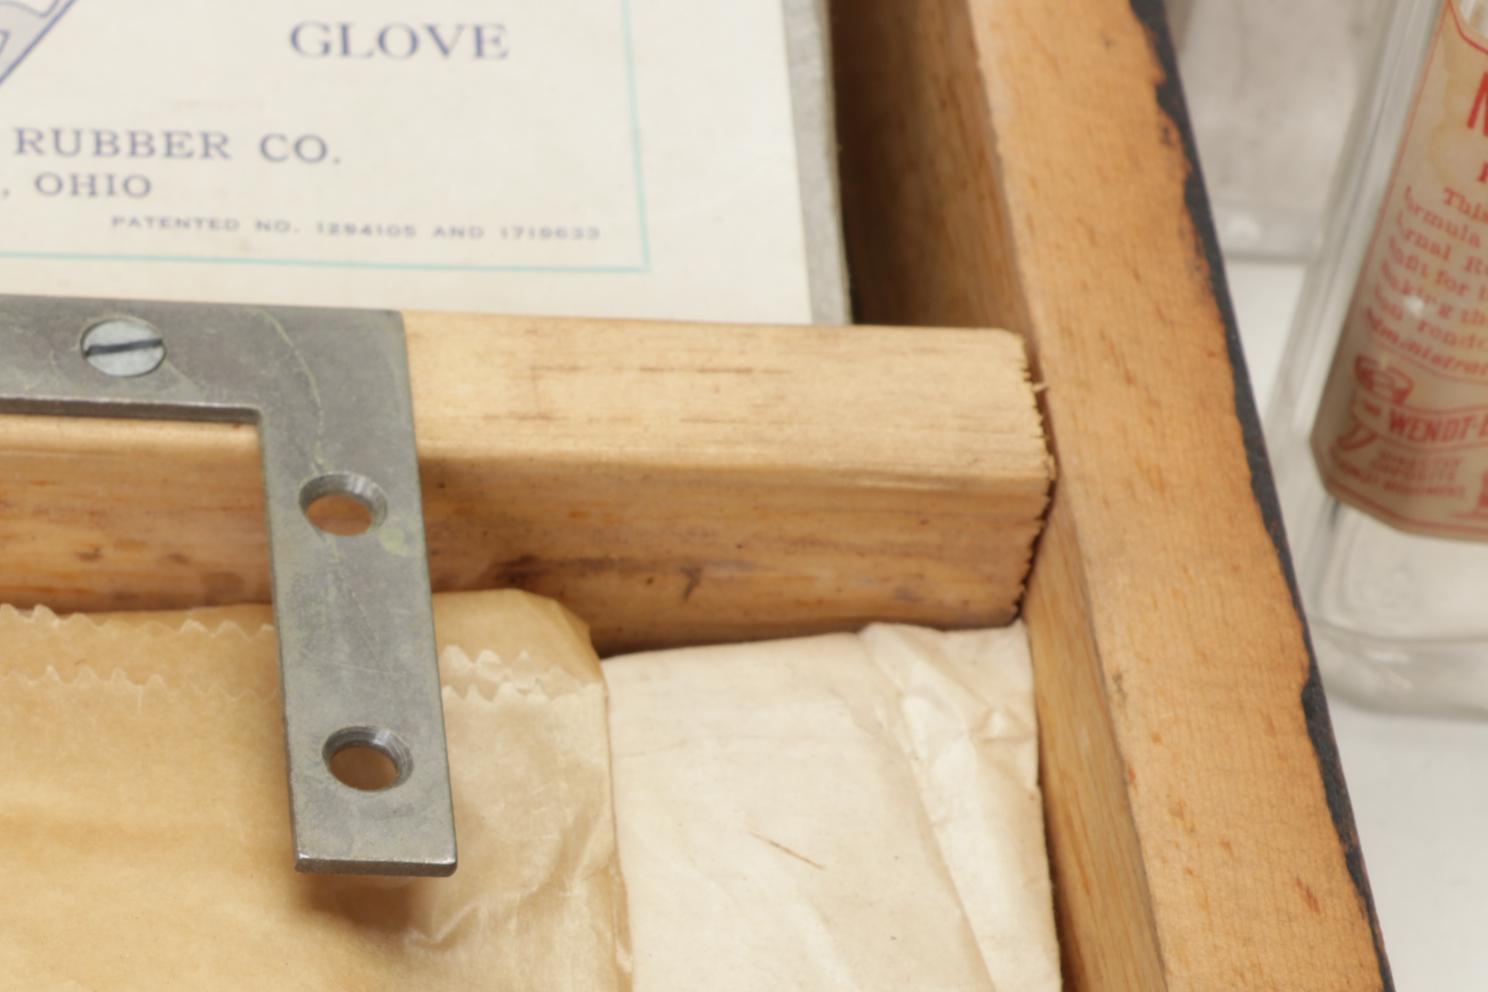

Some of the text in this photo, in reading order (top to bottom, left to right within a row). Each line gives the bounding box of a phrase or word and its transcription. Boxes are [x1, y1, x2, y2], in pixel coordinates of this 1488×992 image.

[288, 20, 510, 60] GLOVE
[14, 126, 232, 161] RUBBER
[258, 133, 342, 165] CO.
[33, 171, 153, 199] OHIO
[111, 215, 241, 232] PATENTED
[432, 224, 485, 240] AND
